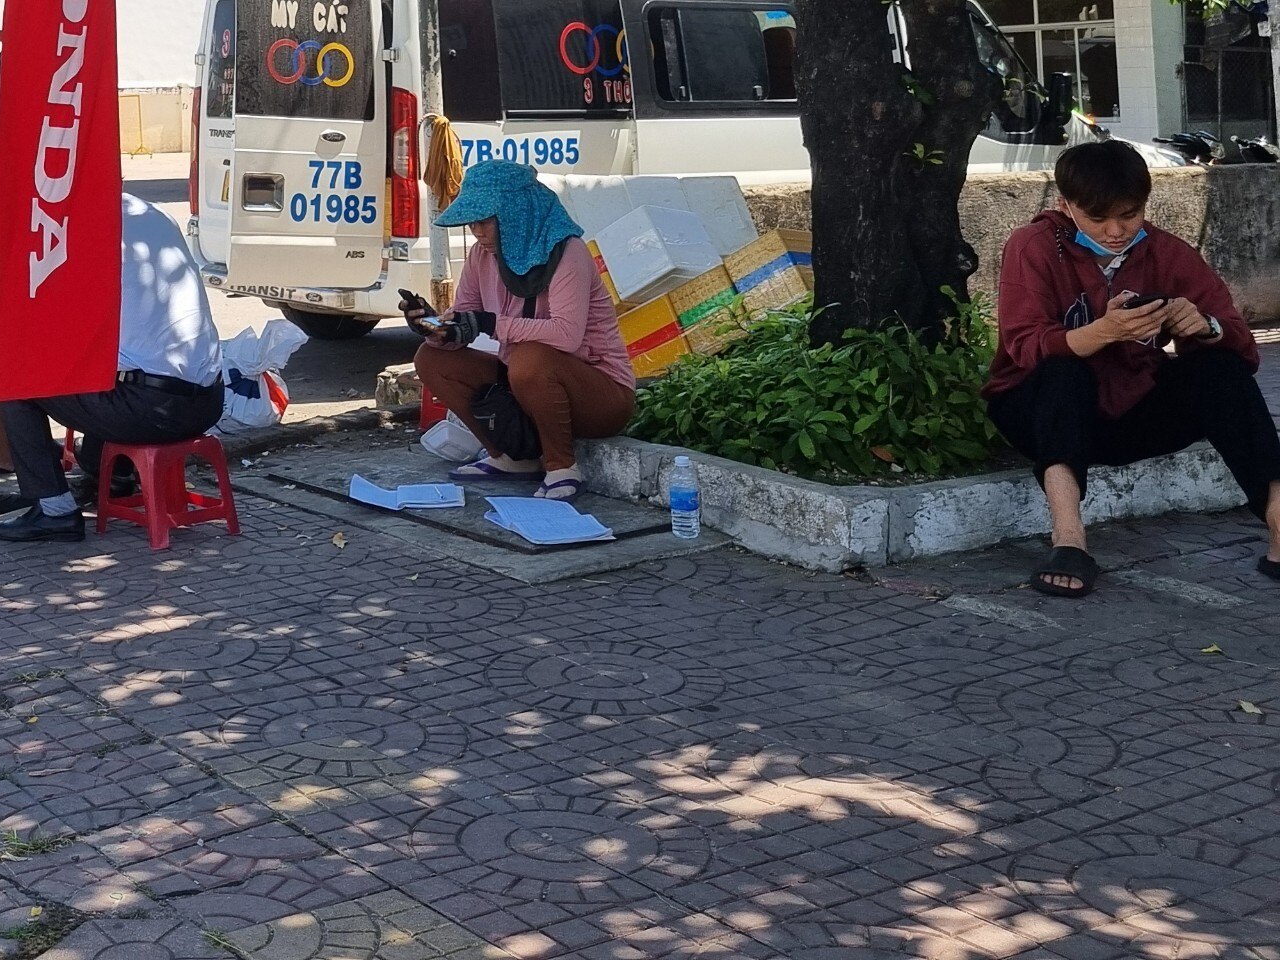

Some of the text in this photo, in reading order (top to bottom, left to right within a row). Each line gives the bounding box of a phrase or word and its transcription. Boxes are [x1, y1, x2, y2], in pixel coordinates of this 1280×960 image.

[583, 77, 593, 104] 3
[308, 160, 362, 189] 77B
[290, 193, 377, 224] 01985
[345, 250, 365, 259] ABS
